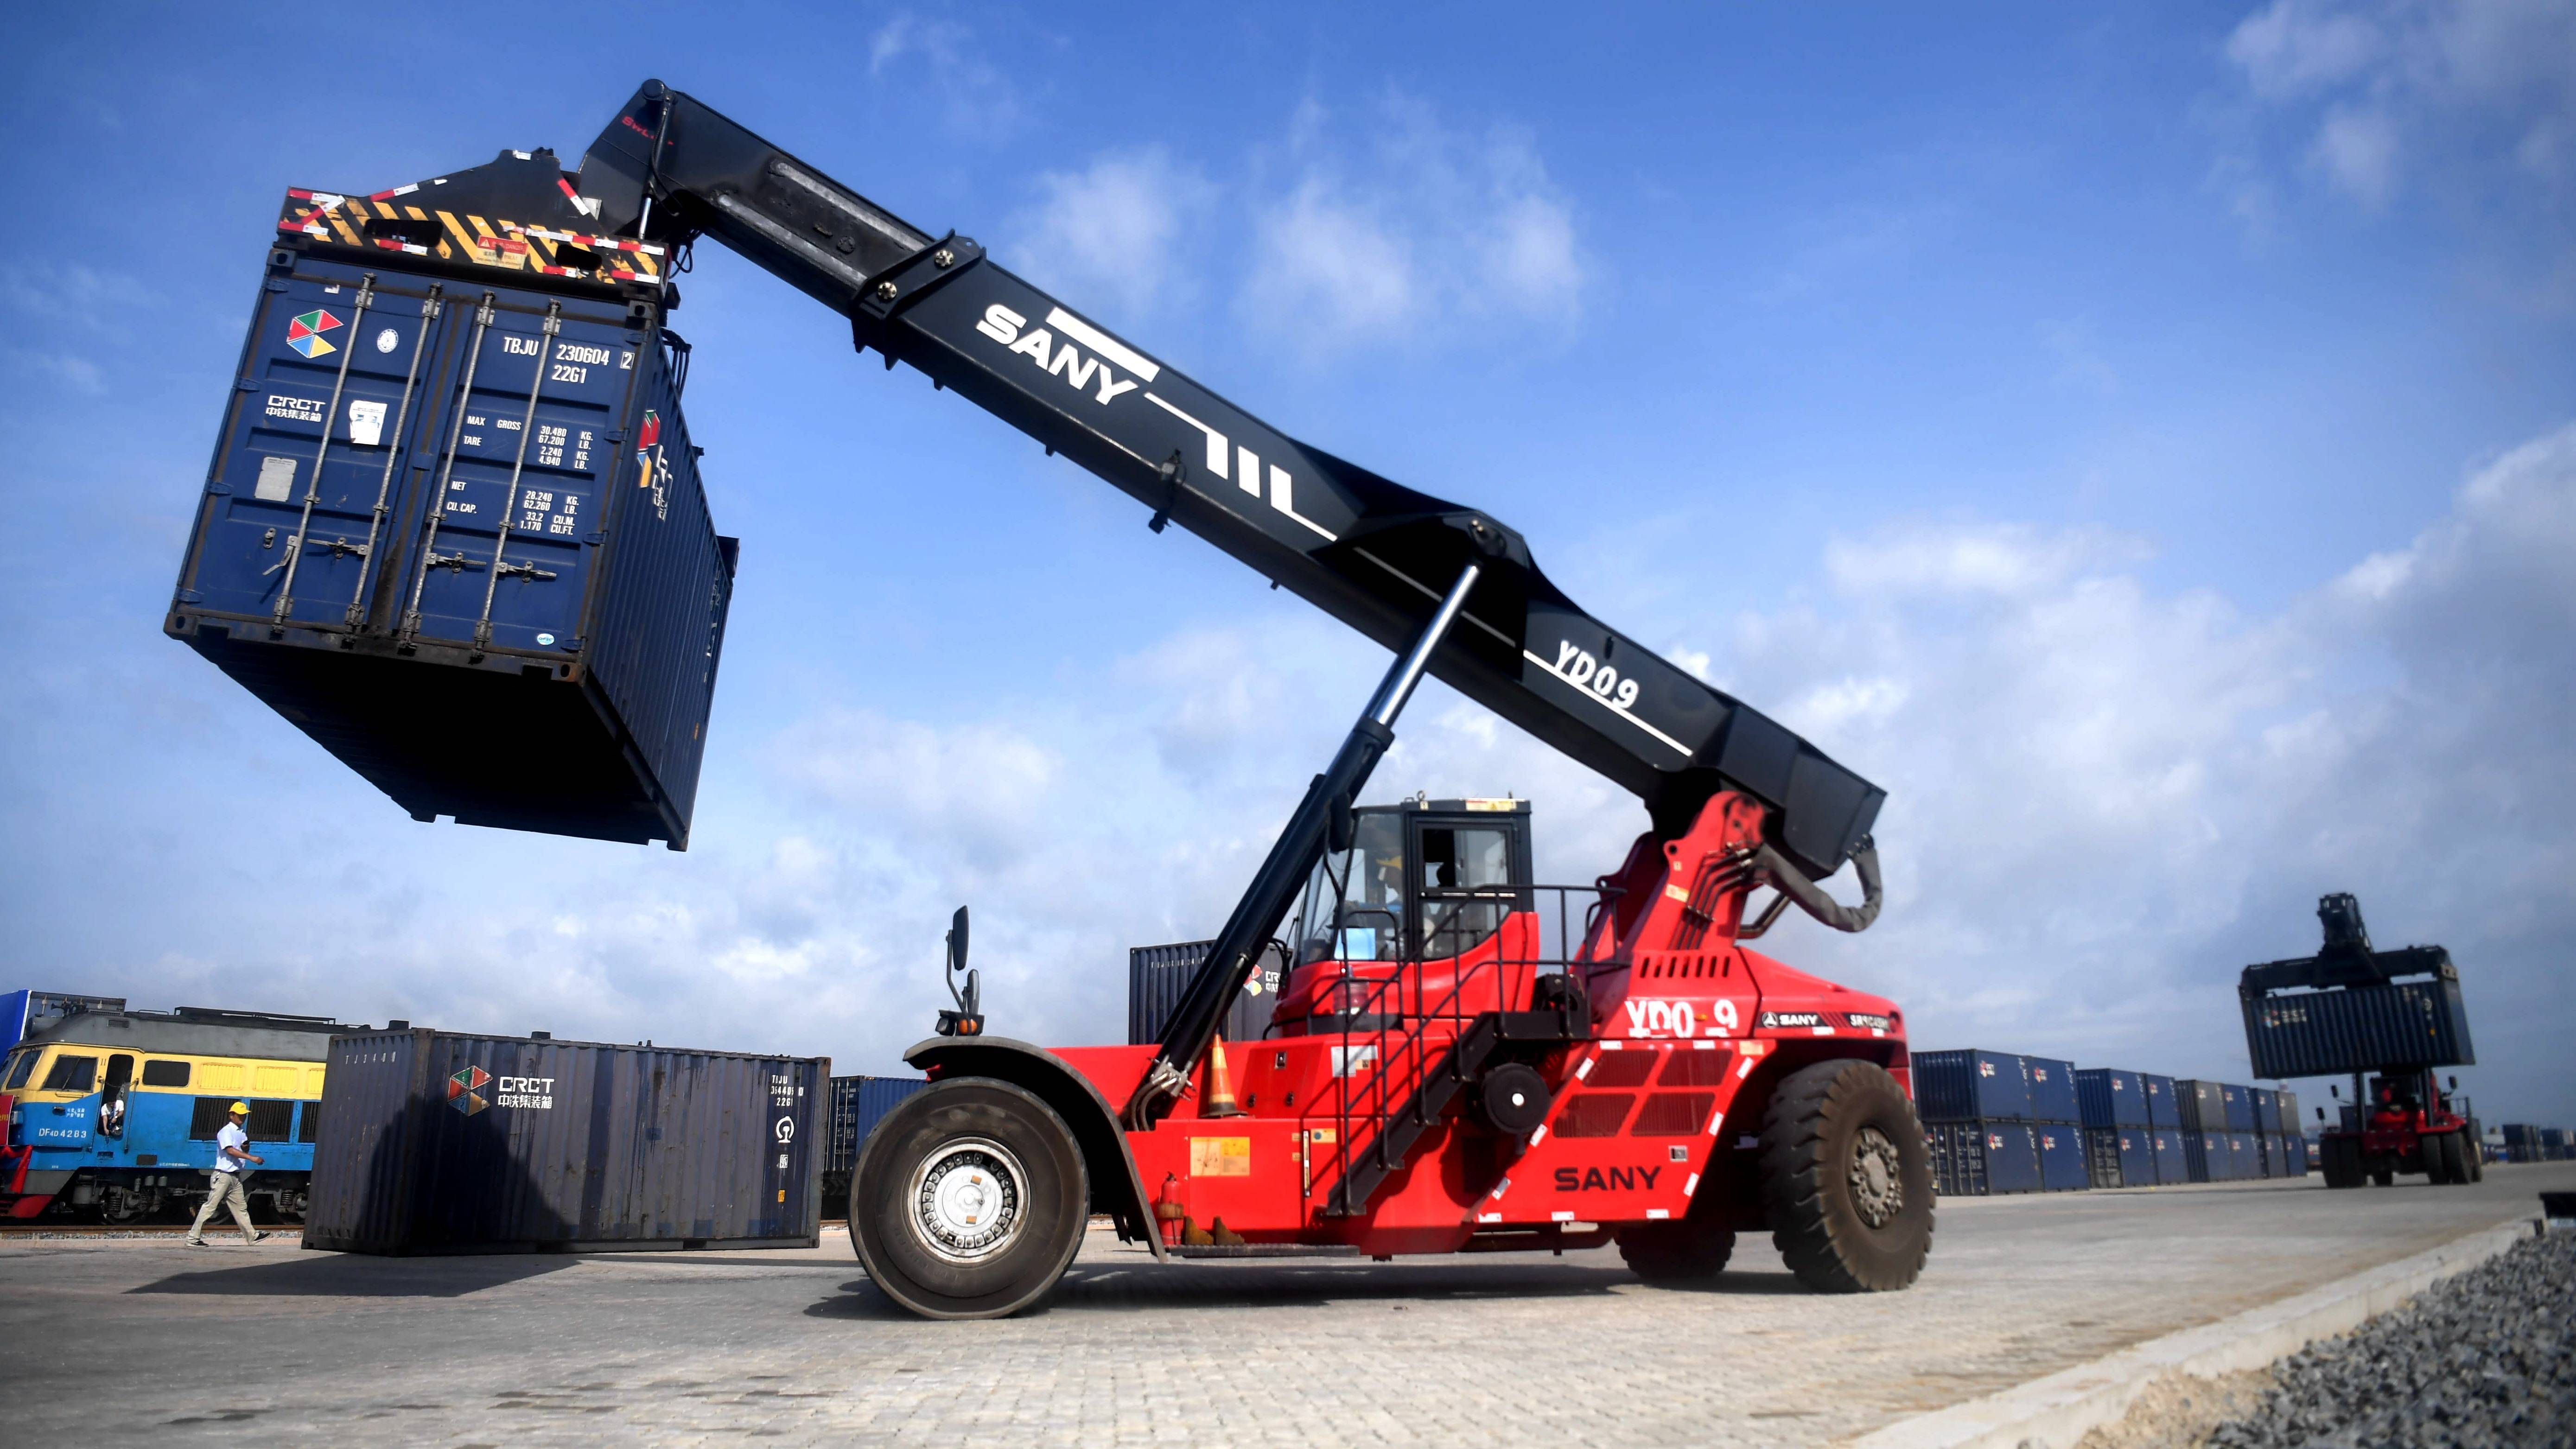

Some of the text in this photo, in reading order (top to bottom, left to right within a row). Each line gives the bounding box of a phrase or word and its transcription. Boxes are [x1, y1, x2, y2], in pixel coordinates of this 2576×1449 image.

[504, 337, 634, 369] TBJU 230604 2
[975, 303, 1139, 406] SANY
[552, 365, 587, 384] 22G1
[268, 395, 326, 411] CRCT
[266, 407, 323, 422] 中铁集装箱
[467, 415, 593, 441] MAX GROSS 30.480 KG.
[464, 435, 589, 461] TARE 2.240 KG.
[538, 435, 592, 450] 67.200 LB.
[539, 455, 587, 470] 4.940 LB.
[452, 481, 579, 506] NET 28.240 KG.
[446, 502, 575, 526] CU. CAP. 33.2 CU.M.
[523, 500, 577, 515] 62.260 LB.
[520, 520, 573, 535] 1.170 CU.FT.
[1554, 639, 1640, 709] YD09
[1779, 1014, 1818, 1026] SANY
[498, 1076, 555, 1093] CRCT
[772, 1074, 788, 1084] TBJU
[497, 1094, 553, 1109] 中铁集装箱
[38, 1128, 87, 1138] DF4D 4283
[1554, 1165, 1662, 1191] SANY
